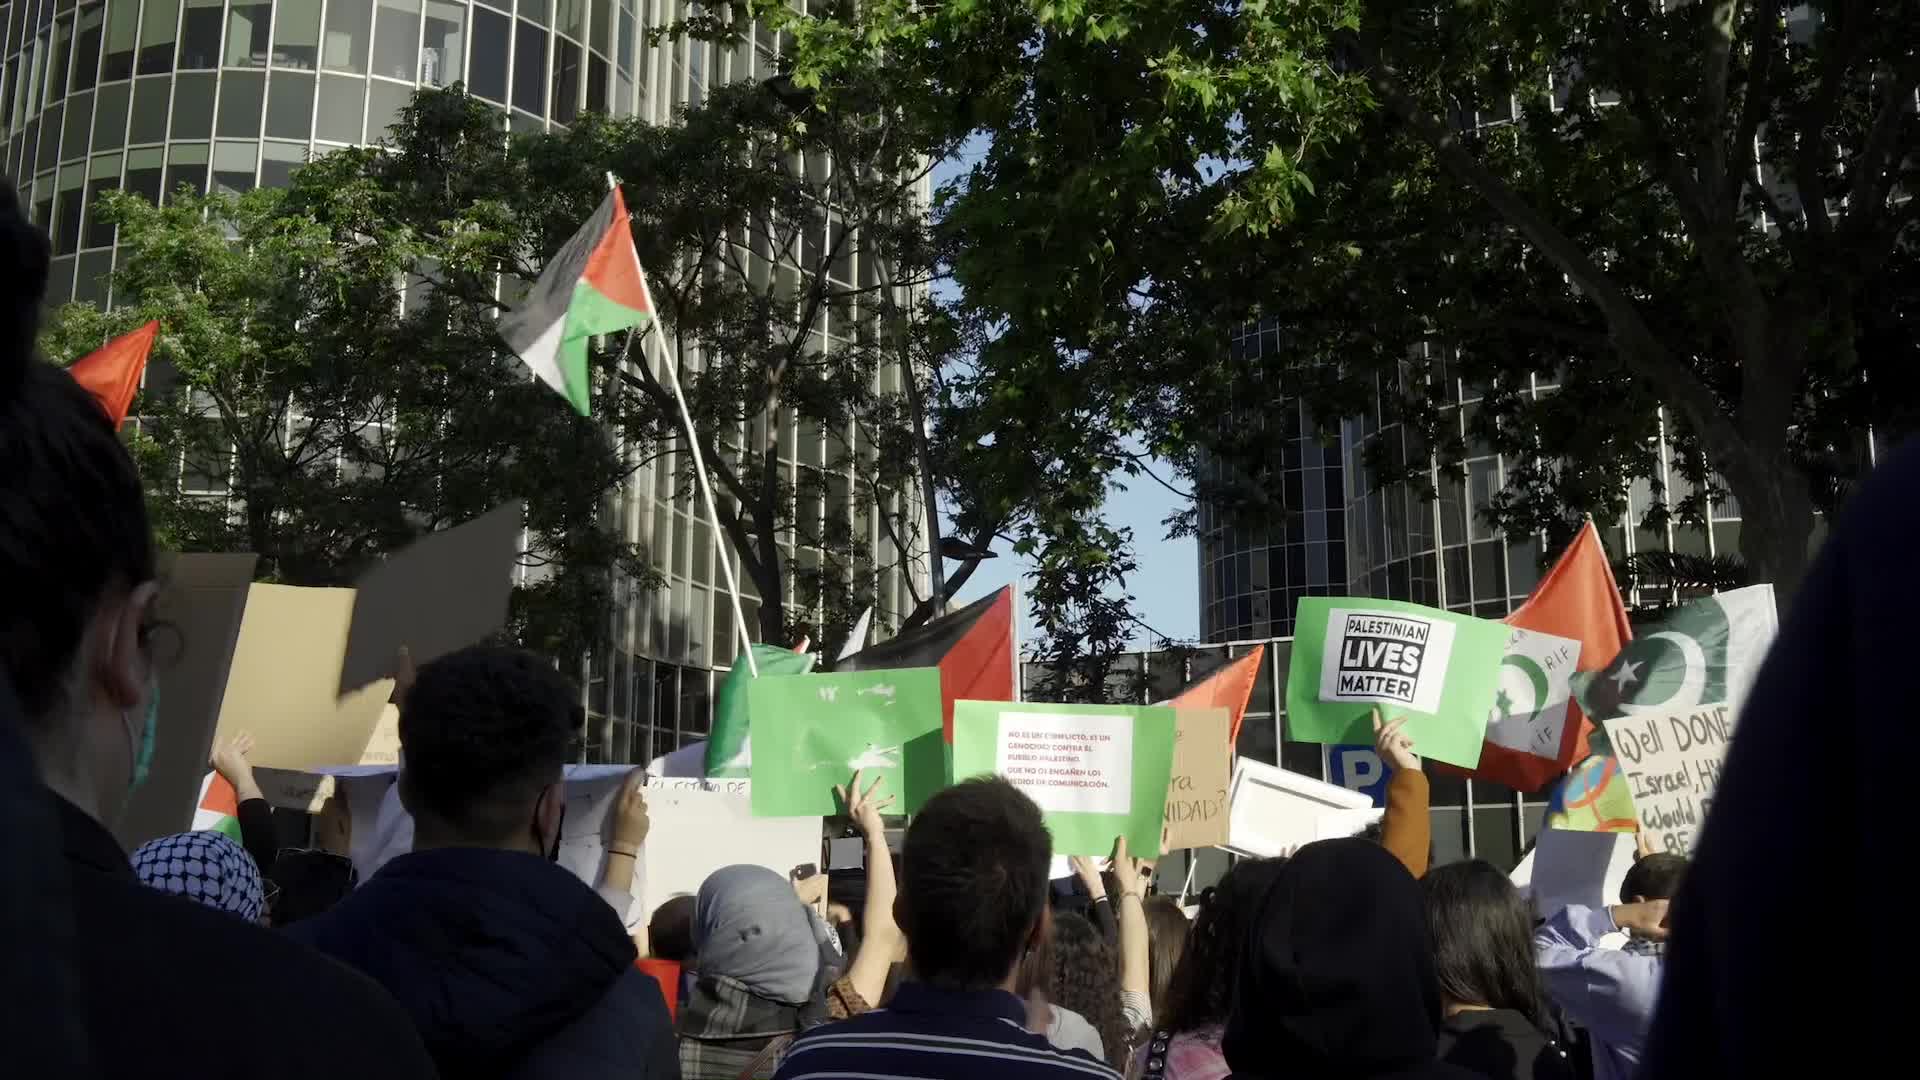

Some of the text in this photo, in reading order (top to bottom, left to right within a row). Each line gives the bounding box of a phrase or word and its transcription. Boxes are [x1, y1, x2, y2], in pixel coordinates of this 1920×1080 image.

[1349, 619, 1426, 641] PALESTINIAN
[1343, 640, 1421, 674] LIVES
[1543, 645, 1569, 671] RIF
[1341, 675, 1411, 698] MATTER
[1008, 731, 1020, 739] NO
[1615, 707, 1732, 764] Well DONE
[1052, 744, 1083, 752] CONTRA
[1007, 766, 1023, 774] QUE
[1049, 767, 1086, 776] ENGAÑEN
[1087, 769, 1101, 777] LOS
[1342, 750, 1382, 790] P
[1048, 779, 1110, 789] COMUNICACIÓN.
[1642, 797, 1697, 830] Would
